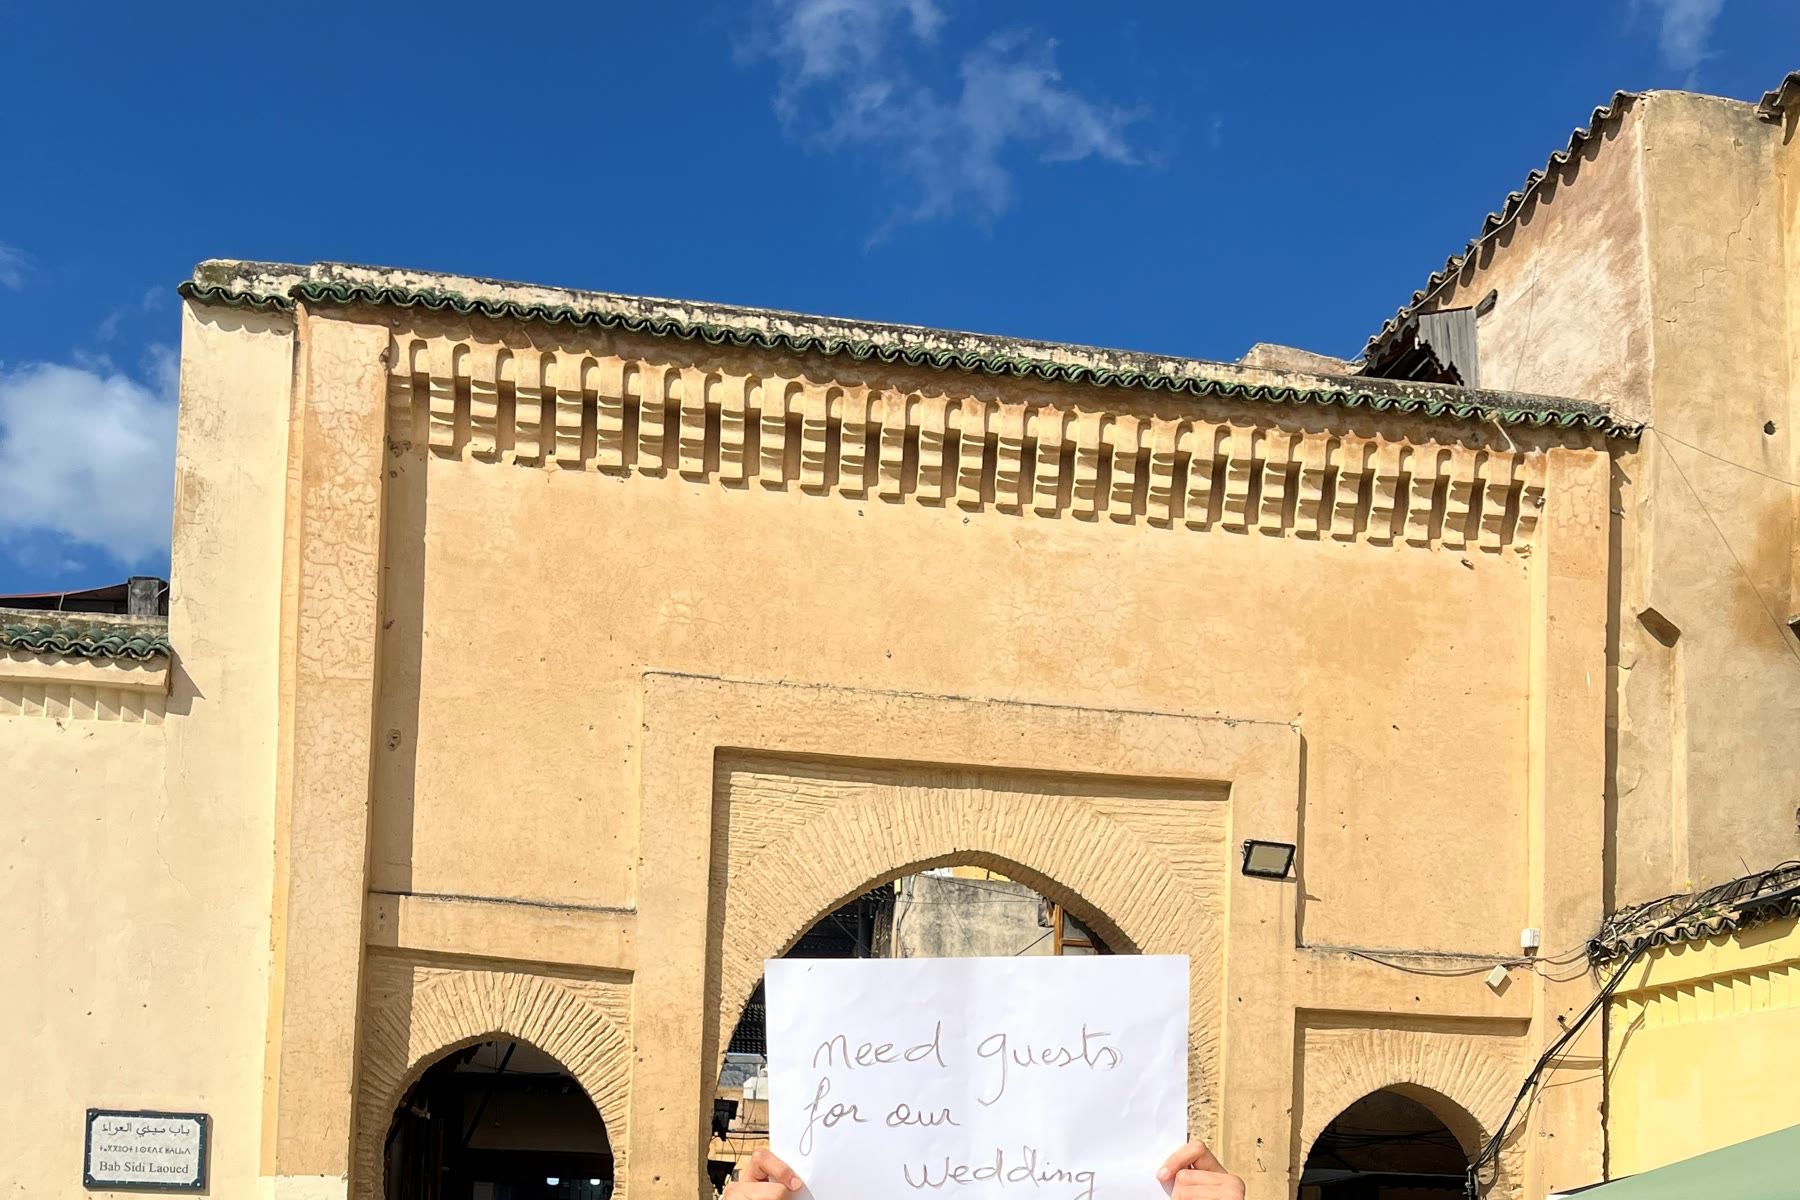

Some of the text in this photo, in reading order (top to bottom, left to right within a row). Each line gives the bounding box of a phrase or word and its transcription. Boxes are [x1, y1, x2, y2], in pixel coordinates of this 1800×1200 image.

[976, 1023, 1123, 1106] guests
[799, 1076, 868, 1156] for
[136, 1125, 166, 1138] سيدي
[169, 1124, 190, 1137] باب
[99, 1160, 121, 1172] Bab
[124, 1161, 145, 1172] Sidi
